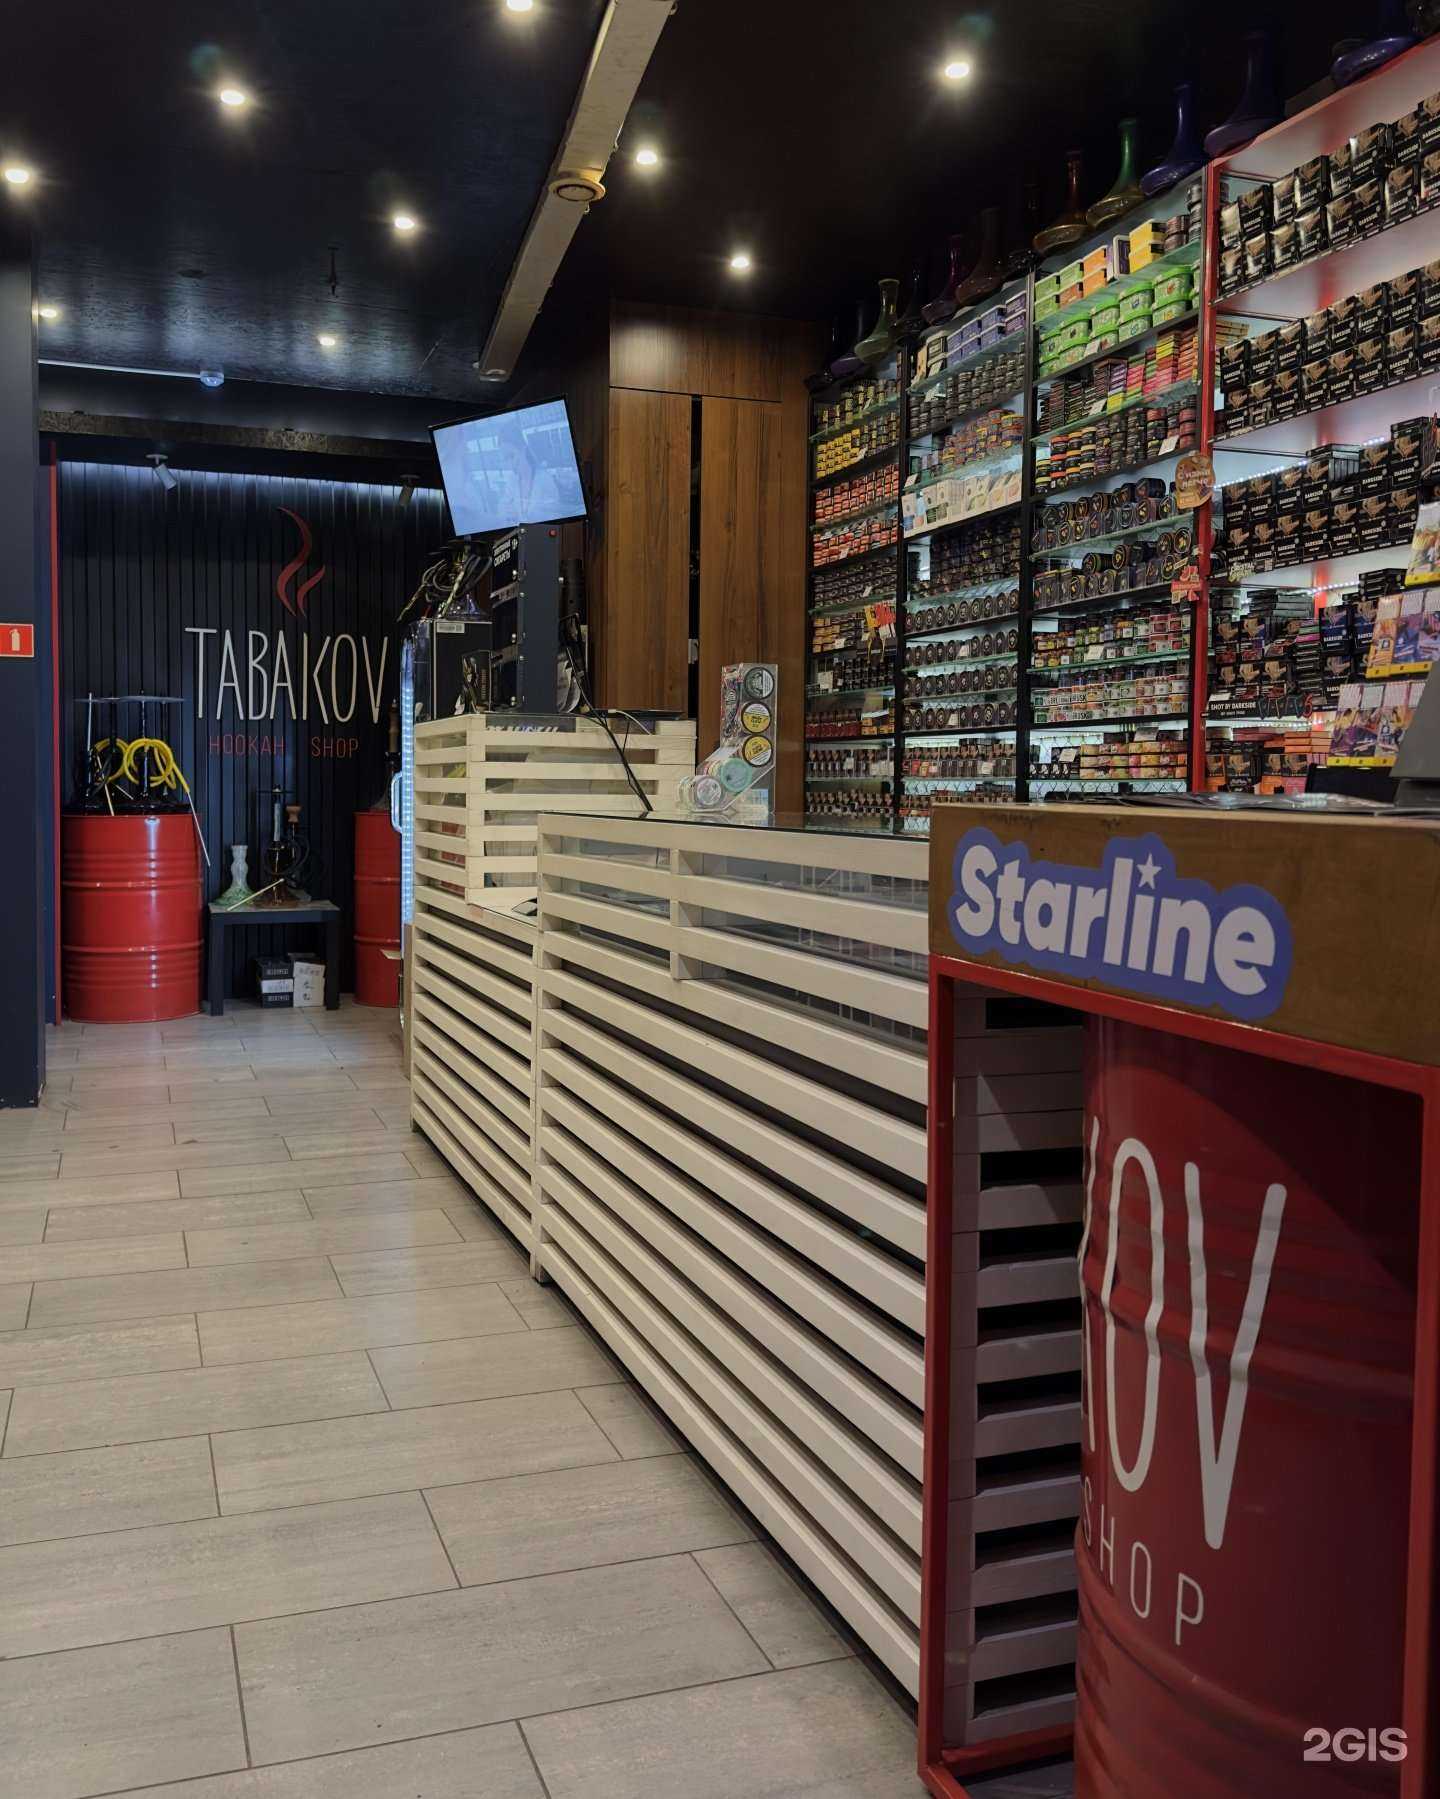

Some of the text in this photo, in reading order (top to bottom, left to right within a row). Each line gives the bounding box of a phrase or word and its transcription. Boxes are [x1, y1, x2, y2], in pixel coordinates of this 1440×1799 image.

[185, 626, 390, 725] TABAKOV
[1231, 701, 1257, 709] DARKSIDE
[210, 734, 359, 759] HOOKAH SHOP
[955, 845, 1276, 994] Starline
